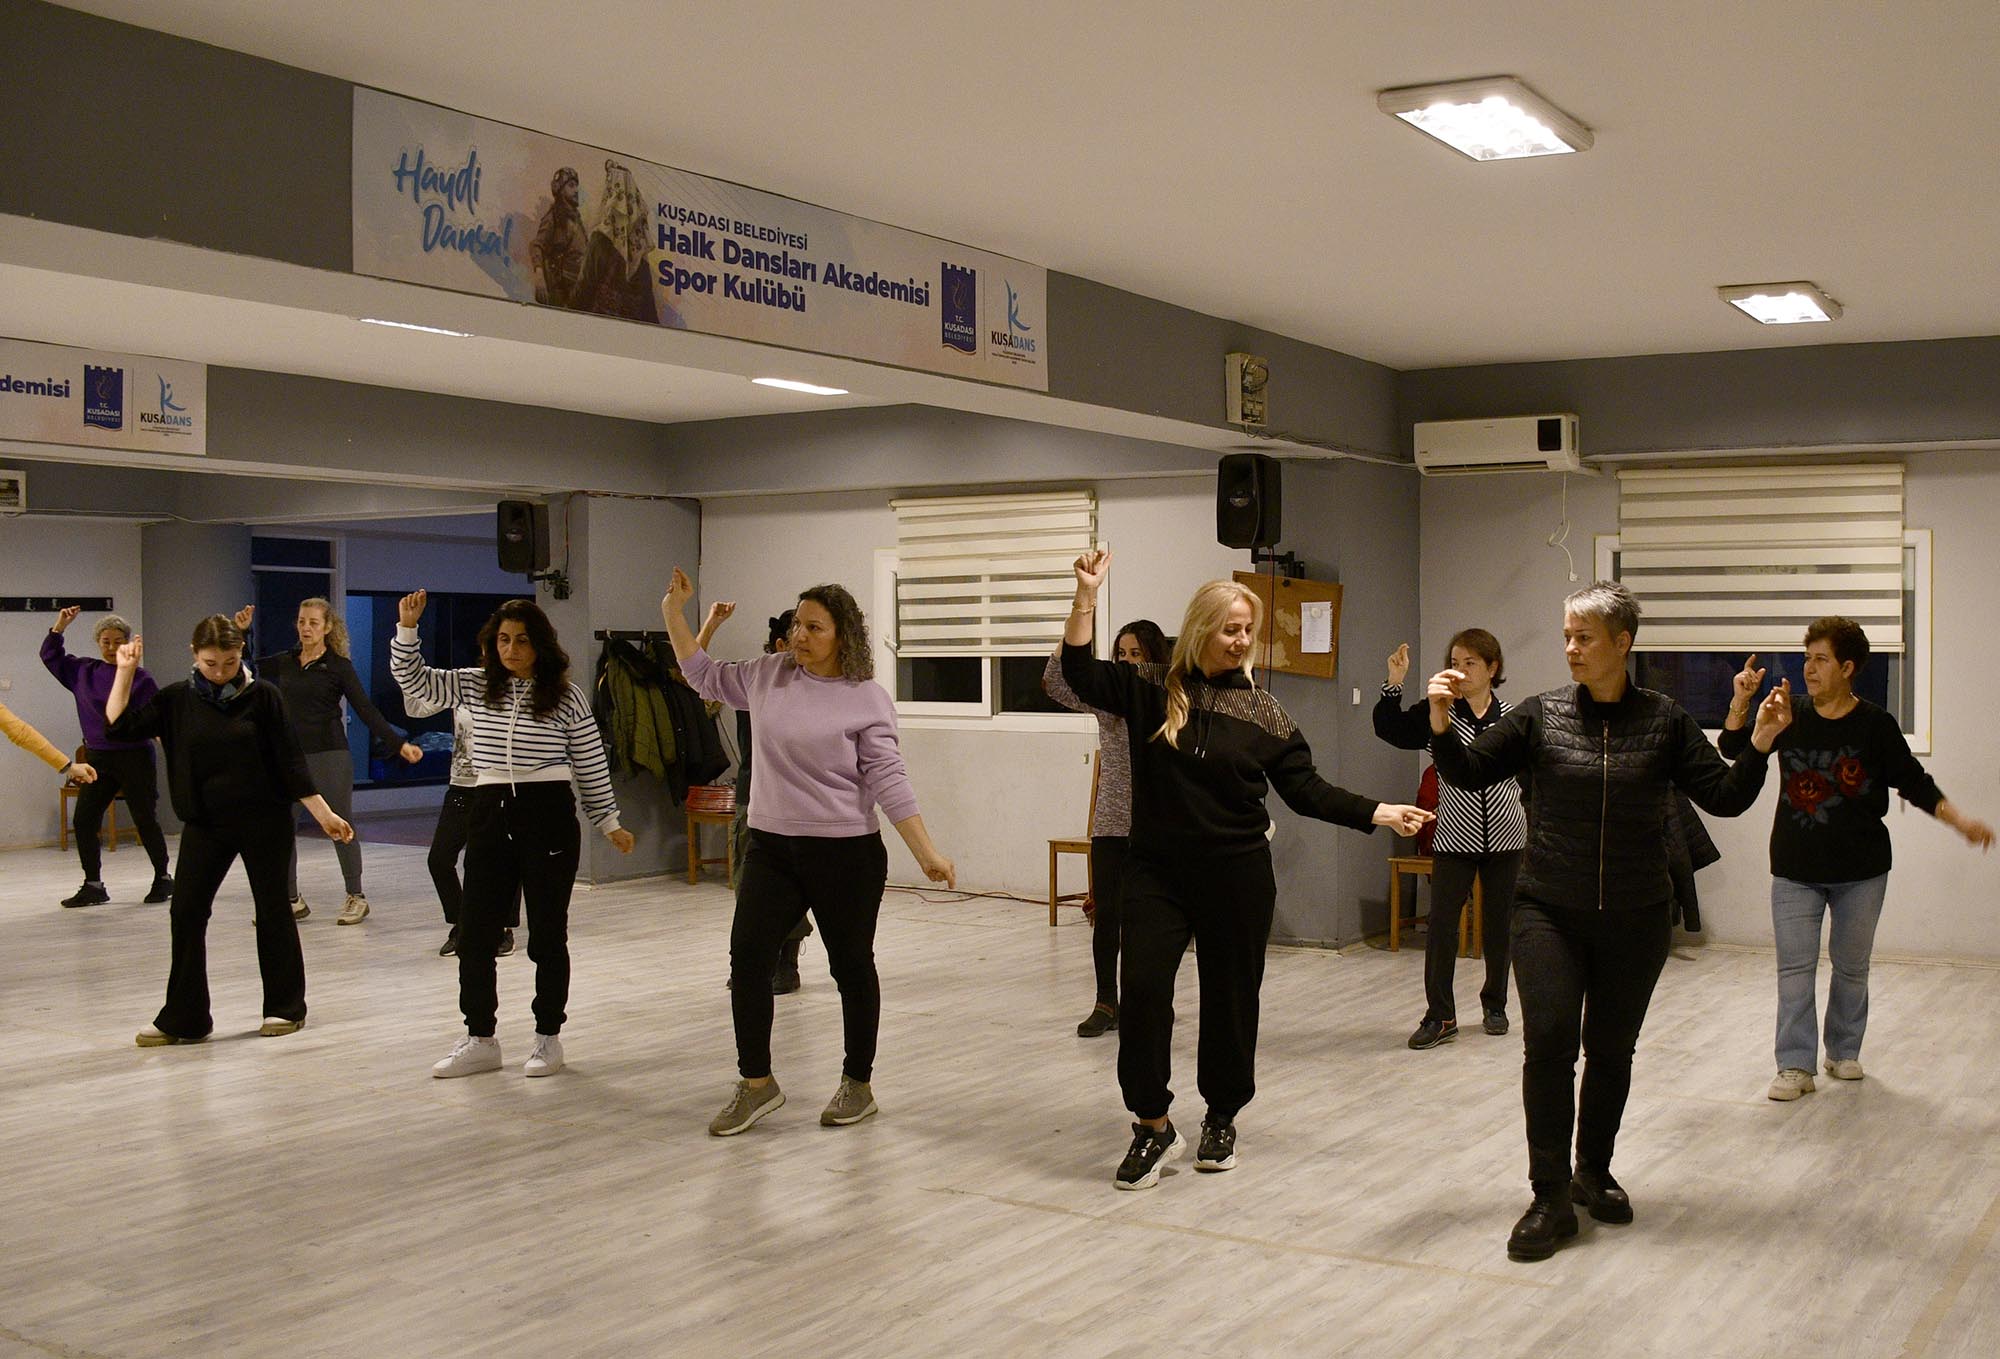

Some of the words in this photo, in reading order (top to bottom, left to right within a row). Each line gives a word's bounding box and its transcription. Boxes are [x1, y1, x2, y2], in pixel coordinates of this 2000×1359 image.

[392, 149, 481, 216] Haydi
[422, 204, 513, 268] Dansa!
[658, 202, 730, 233] KUŞADASI
[733, 220, 808, 251] BELEDİYESİ
[657, 223, 716, 261] Halk
[722, 238, 817, 283] Dansları
[822, 262, 930, 307] Akademisi
[658, 259, 718, 295] Spor
[723, 272, 806, 313] Kulübü
